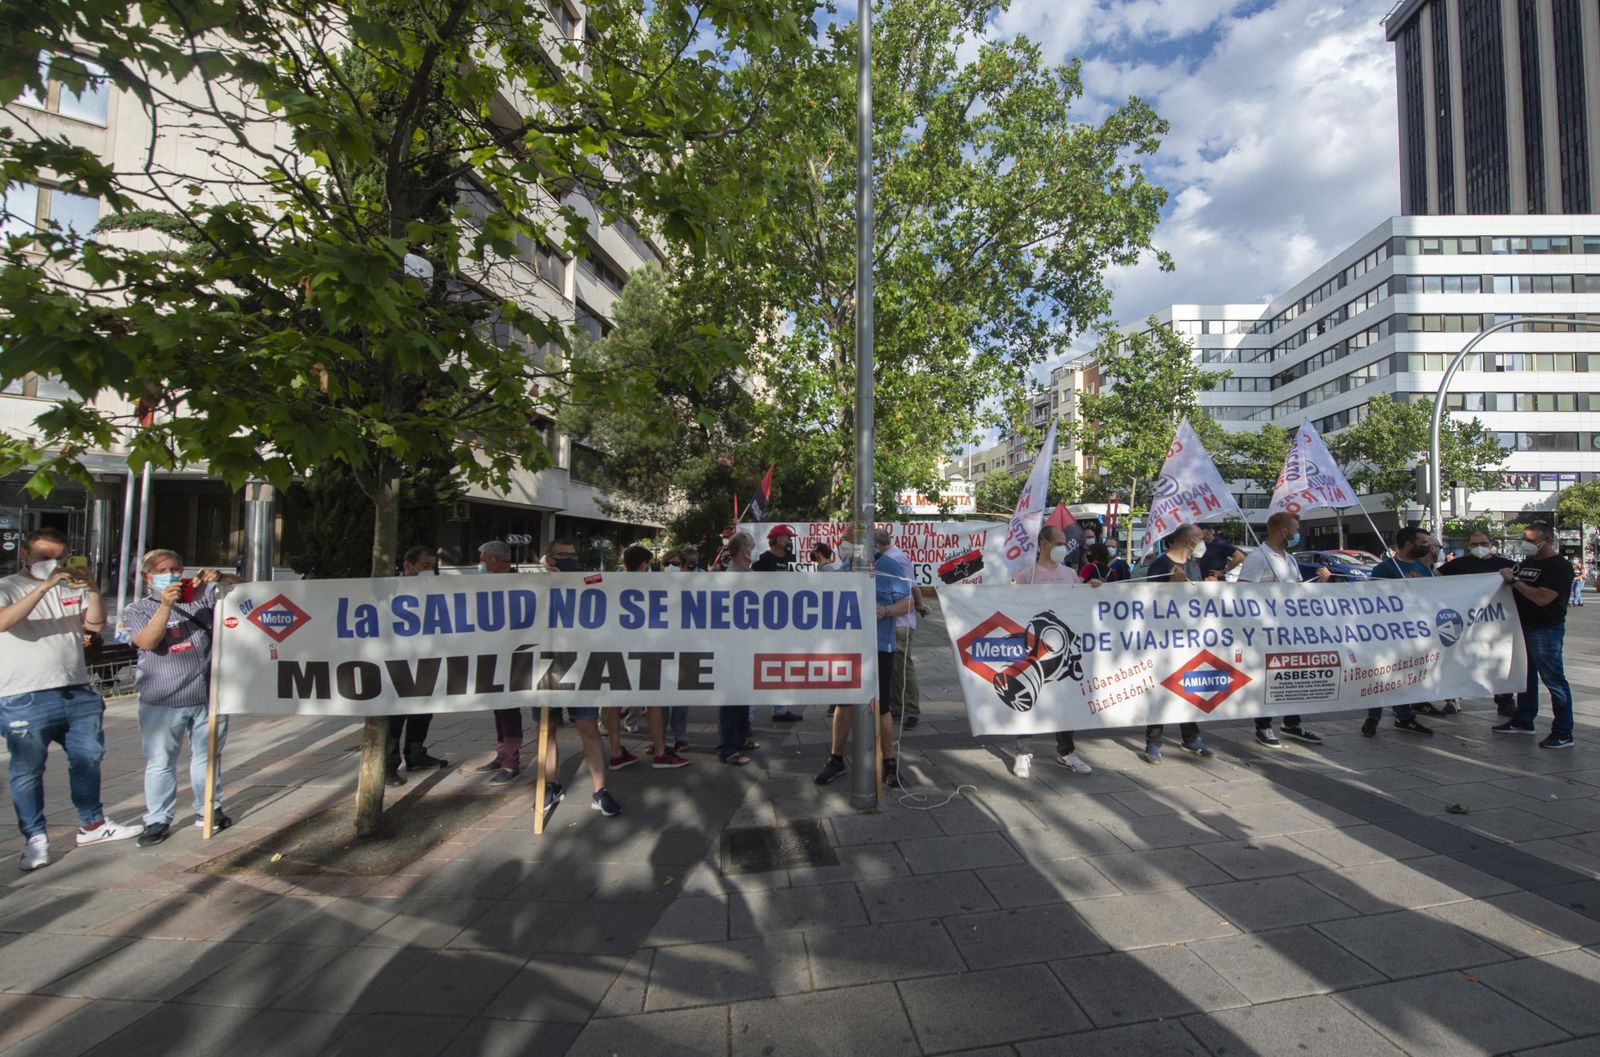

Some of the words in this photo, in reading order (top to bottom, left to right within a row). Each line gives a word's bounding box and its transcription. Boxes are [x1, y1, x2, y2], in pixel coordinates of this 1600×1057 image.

[901, 522, 937, 536] TOTAL
[969, 529, 987, 550] YA!
[239, 599, 254, 615] en
[337, 597, 379, 638] La
[391, 590, 536, 637] SALUD
[548, 588, 607, 629] NO
[619, 589, 669, 630] SE
[680, 590, 862, 630] NEGOCIA
[1098, 600, 1145, 621] POR
[1153, 599, 1179, 620] LA
[1188, 598, 1261, 619] SALUD
[1265, 599, 1277, 617] Y
[1284, 595, 1404, 617] SEGURIDAD
[262, 613, 292, 624] Metro
[1083, 631, 1112, 652] DE
[1119, 627, 1234, 651] VIAJEROS
[1242, 627, 1256, 647] Y
[1262, 620, 1431, 646] TRABAJADORES
[975, 640, 1023, 659] Metro
[1281, 654, 1339, 667] PELIGRO
[277, 643, 715, 701] MOVILÍZATE
[760, 660, 853, 682] CCOO
[1274, 670, 1334, 680] ASBESTO
[1184, 676, 1228, 688] AMIANTO
[1360, 679, 1402, 697] médicos
[1088, 675, 1156, 716] Dimisión!!
